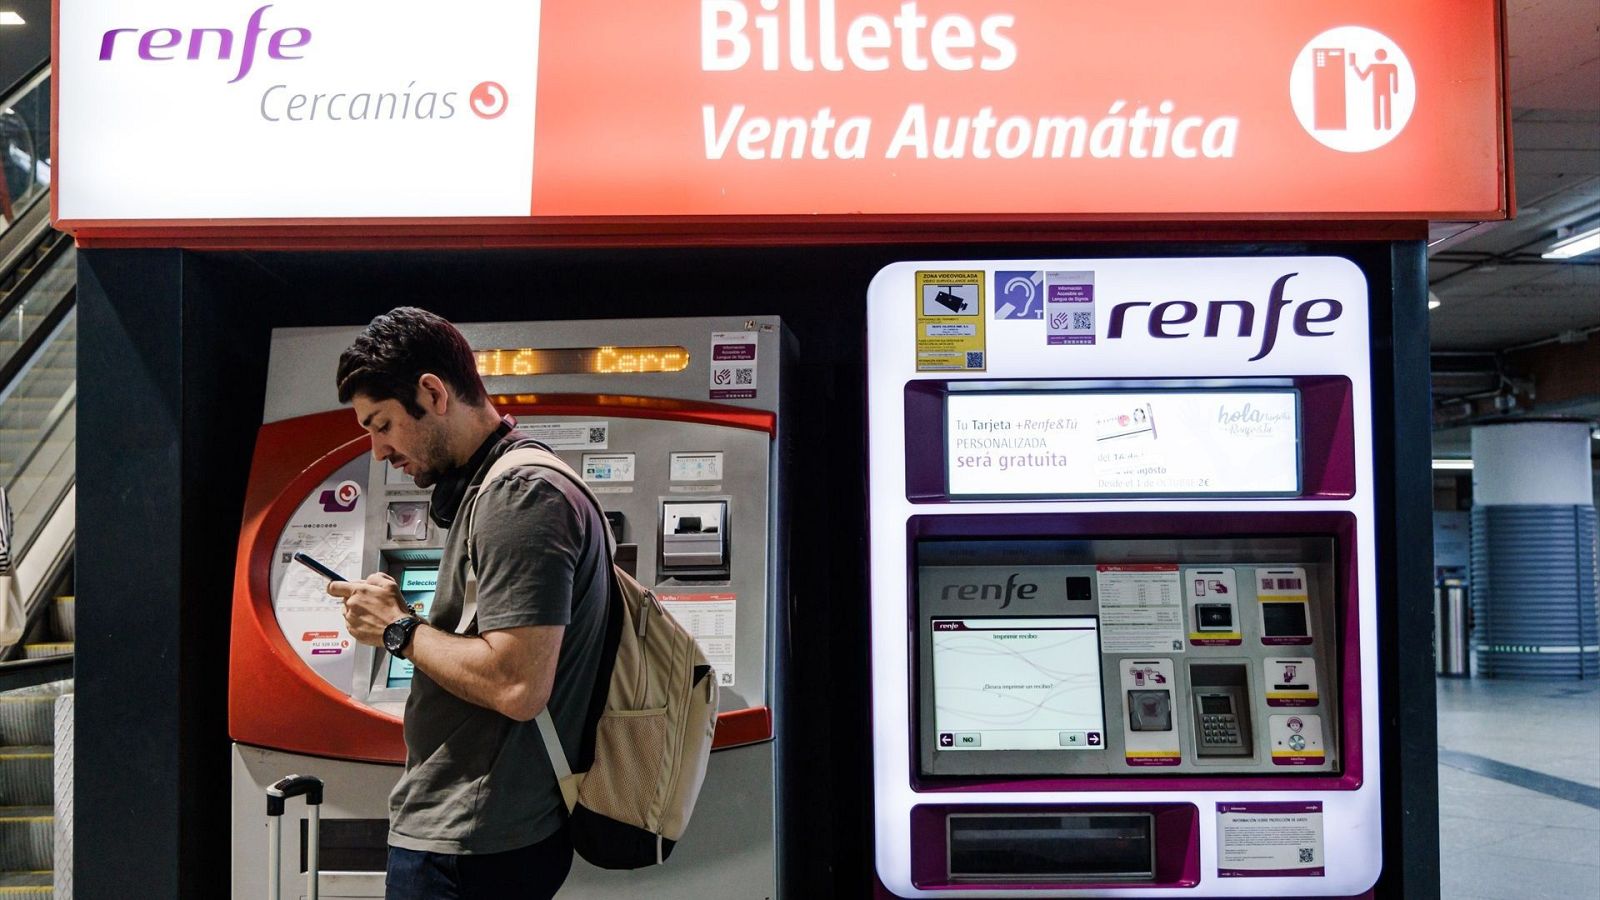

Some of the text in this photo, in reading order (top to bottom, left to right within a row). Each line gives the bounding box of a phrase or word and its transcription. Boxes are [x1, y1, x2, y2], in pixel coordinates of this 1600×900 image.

[99, 4, 312, 84] renfe
[700, 0, 1018, 71] Billetes
[260, 81, 458, 122] Cercanías
[702, 100, 1240, 160] Venta Automática
[1035, 310, 1043, 319] T
[1107, 272, 1343, 362] renfe
[597, 346, 690, 373] Cerc
[957, 419, 968, 431] Tu
[972, 419, 1011, 432] Tarjeta
[957, 438, 1047, 449] PERSONALIZADA
[957, 451, 1067, 471] será gratuita
[941, 573, 1038, 609] renfe
[939, 622, 959, 630] renfe
